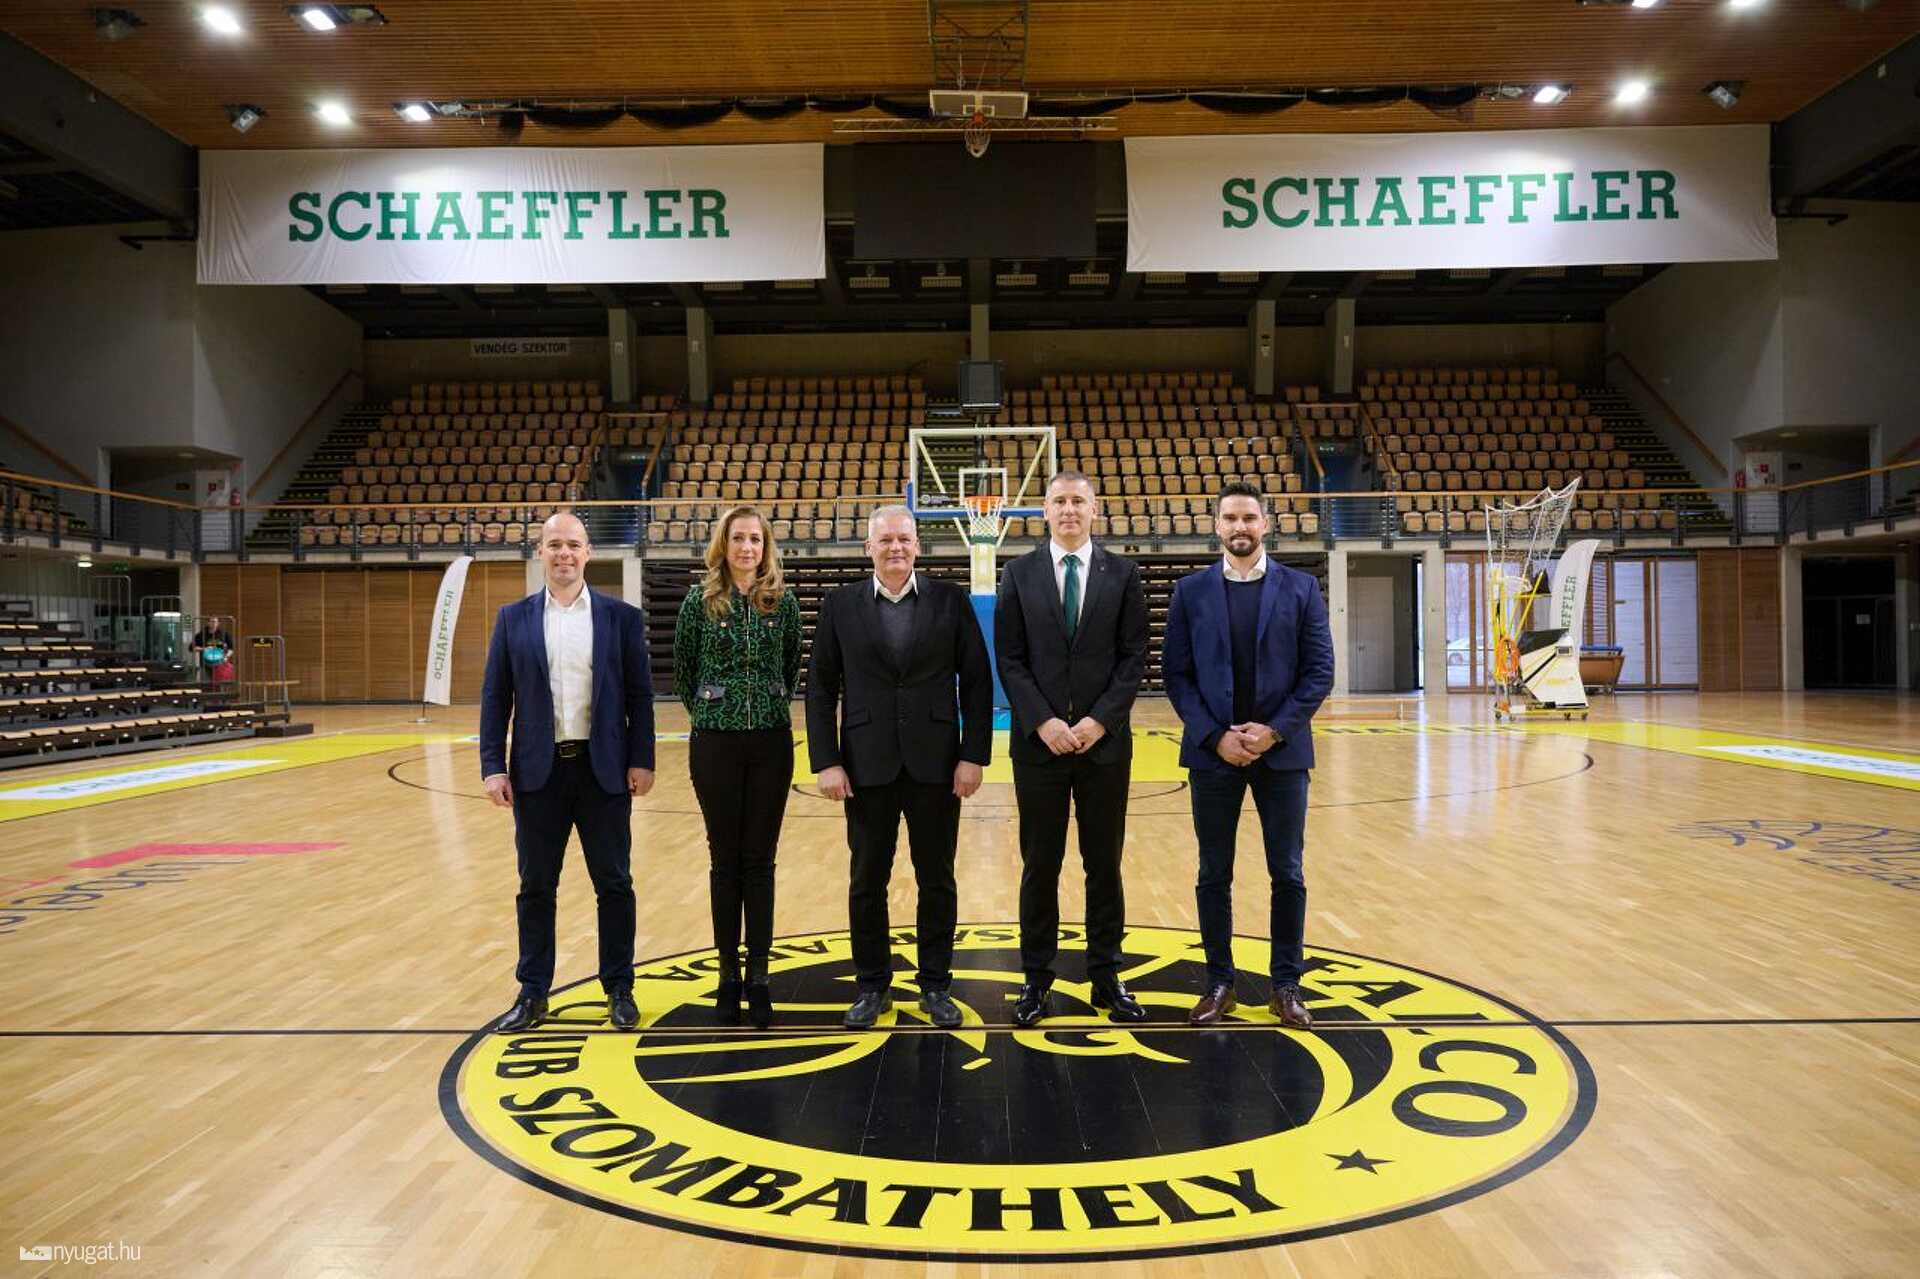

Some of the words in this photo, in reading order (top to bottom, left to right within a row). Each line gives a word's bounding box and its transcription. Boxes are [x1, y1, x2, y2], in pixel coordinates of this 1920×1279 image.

[288, 189, 730, 242] SCHAEFFLER
[1222, 170, 1680, 228] SCHAEFFLER
[499, 1086, 1286, 1233] SZOMBATHELY
